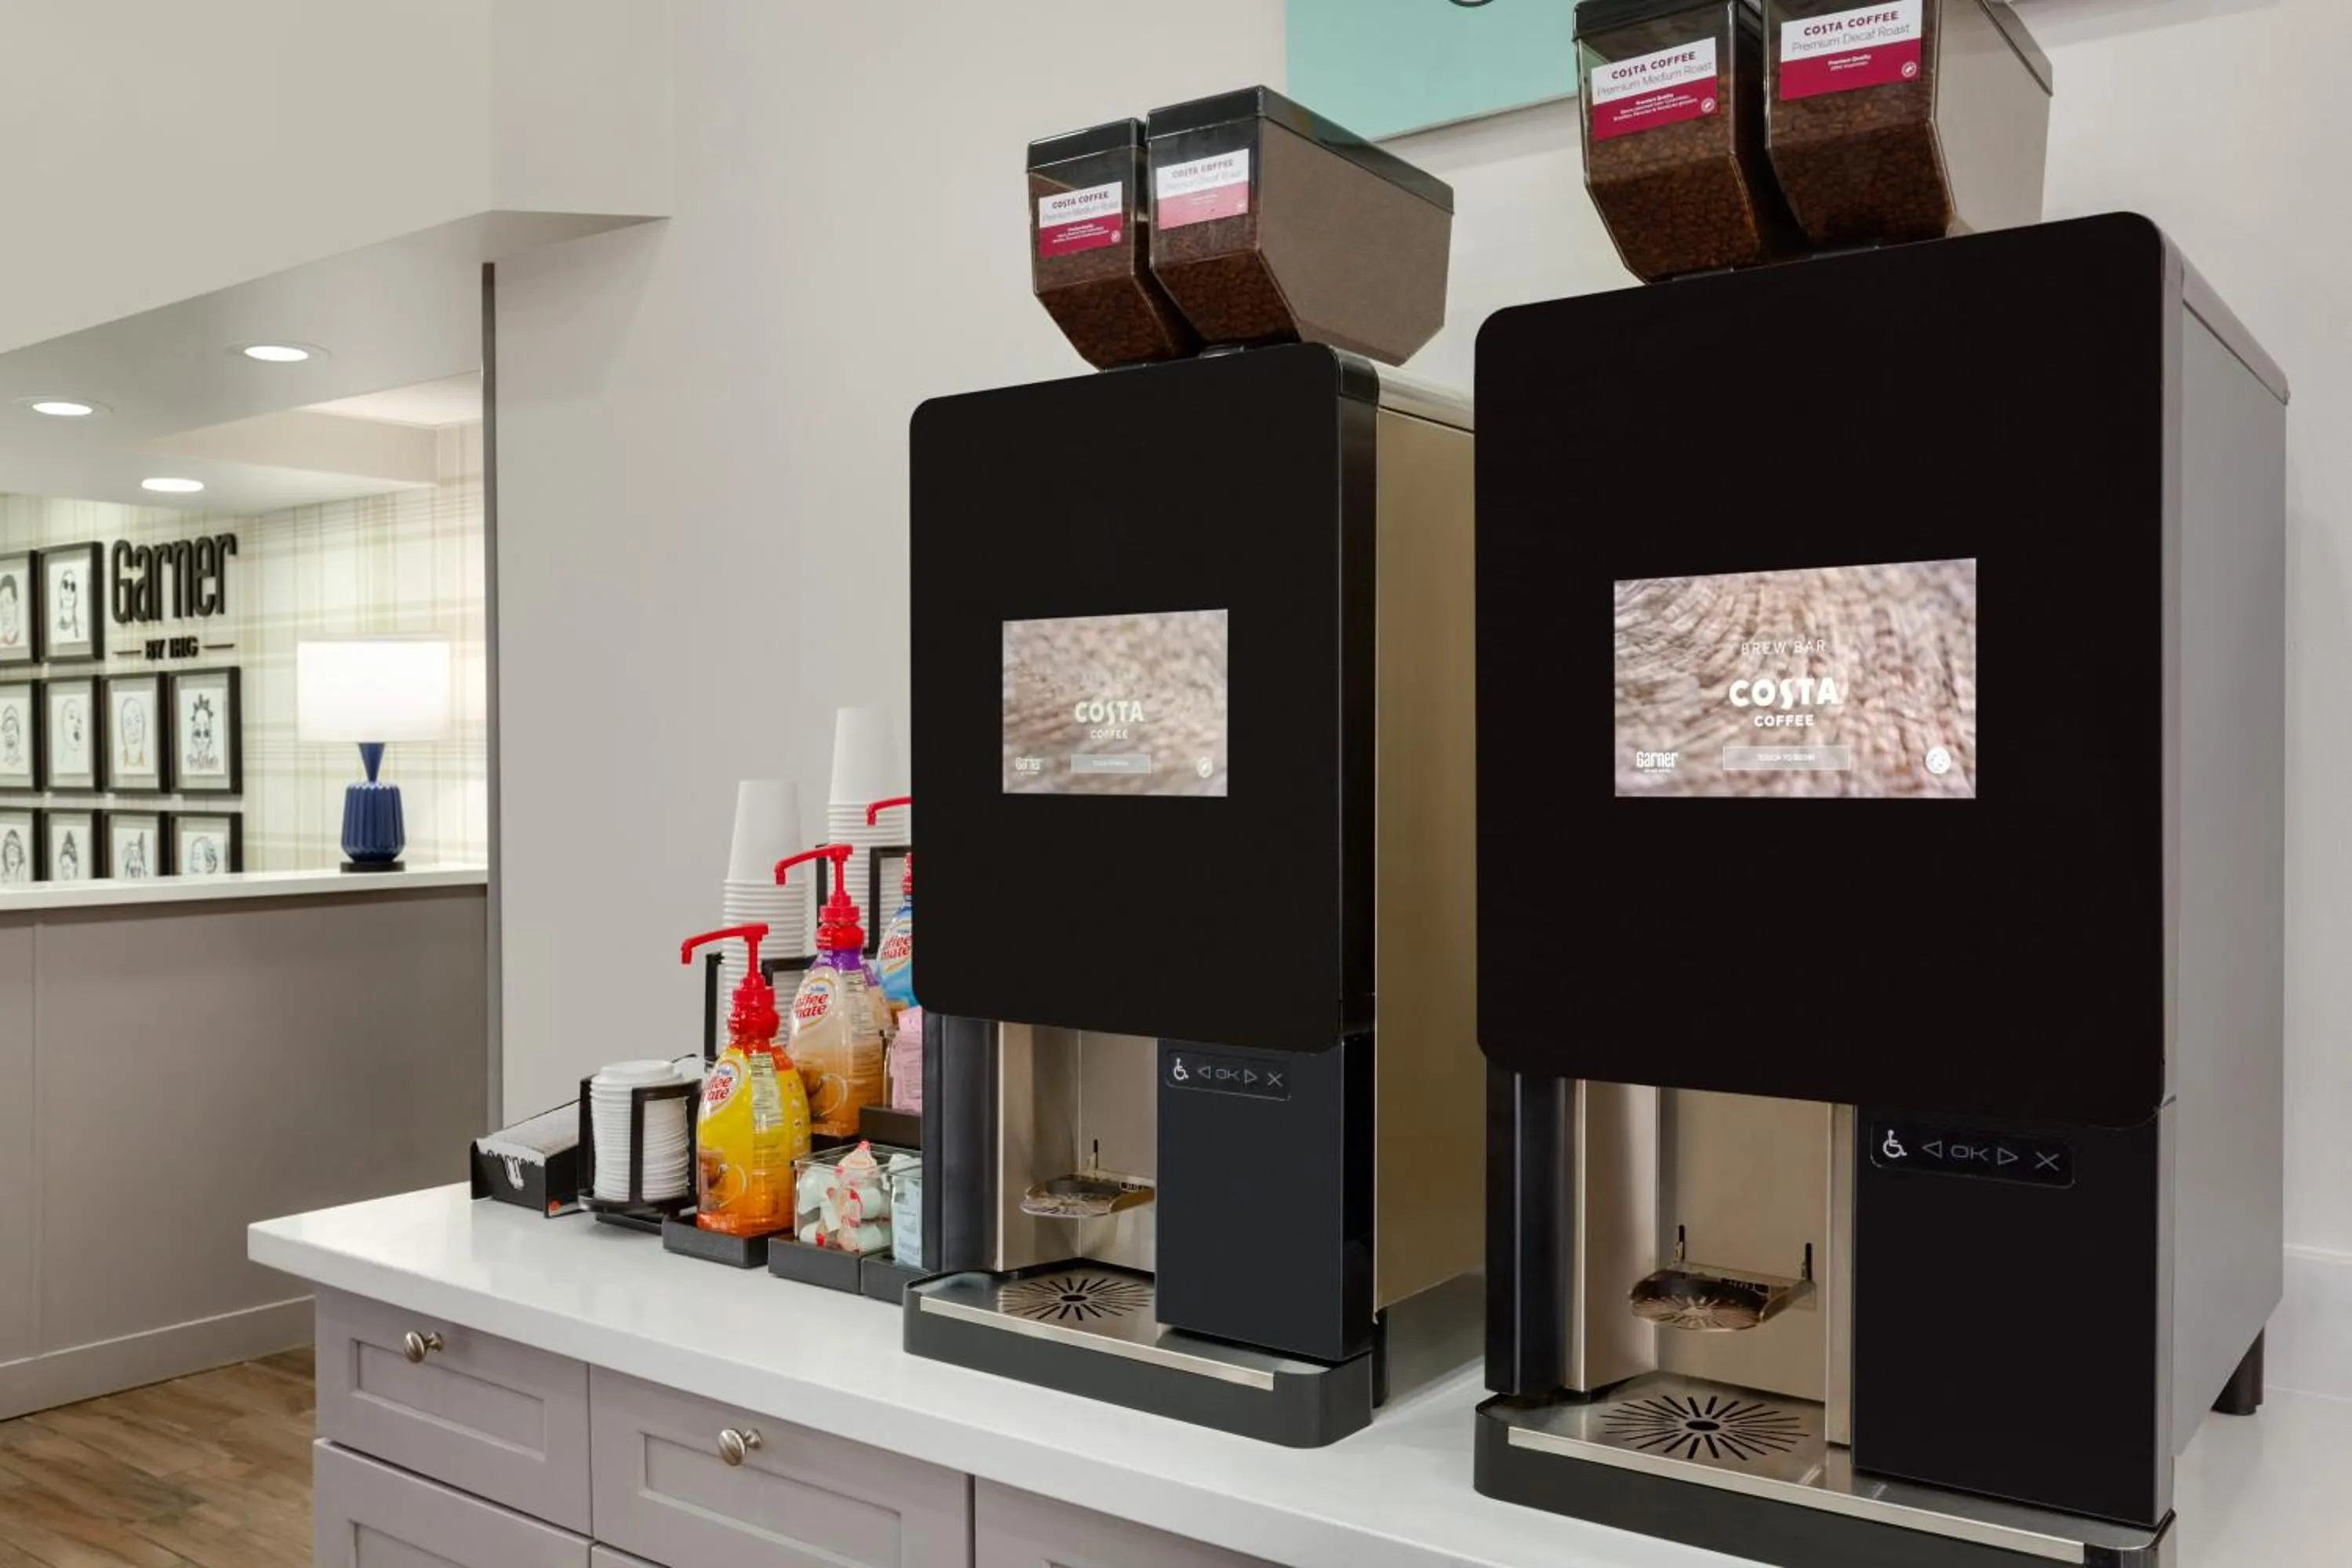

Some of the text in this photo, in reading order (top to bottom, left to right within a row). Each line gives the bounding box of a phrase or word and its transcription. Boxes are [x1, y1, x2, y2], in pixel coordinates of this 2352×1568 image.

[1804, 10, 1898, 36] COSTA COFFEE
[1792, 38, 1840, 53] Premium
[1878, 24, 1911, 38] Roast
[1611, 51, 1696, 79] COSTA COFFEE
[1597, 62, 1711, 96] Premium Medium Roast
[1052, 191, 1109, 209] COSTA COFFEE
[111, 532, 238, 624] Garner
[145, 639, 166, 660] BY
[1741, 638, 1826, 655] BREW BAR
[1729, 677, 1839, 710] COSTA
[1074, 700, 1144, 725] COSTA
[1754, 713, 1814, 727] COFFEE
[1091, 729, 1129, 739] COFFEE
[1636, 751, 1679, 768] Garner
[1215, 1068, 1241, 1081] OK
[1949, 1145, 1990, 1161] OK
